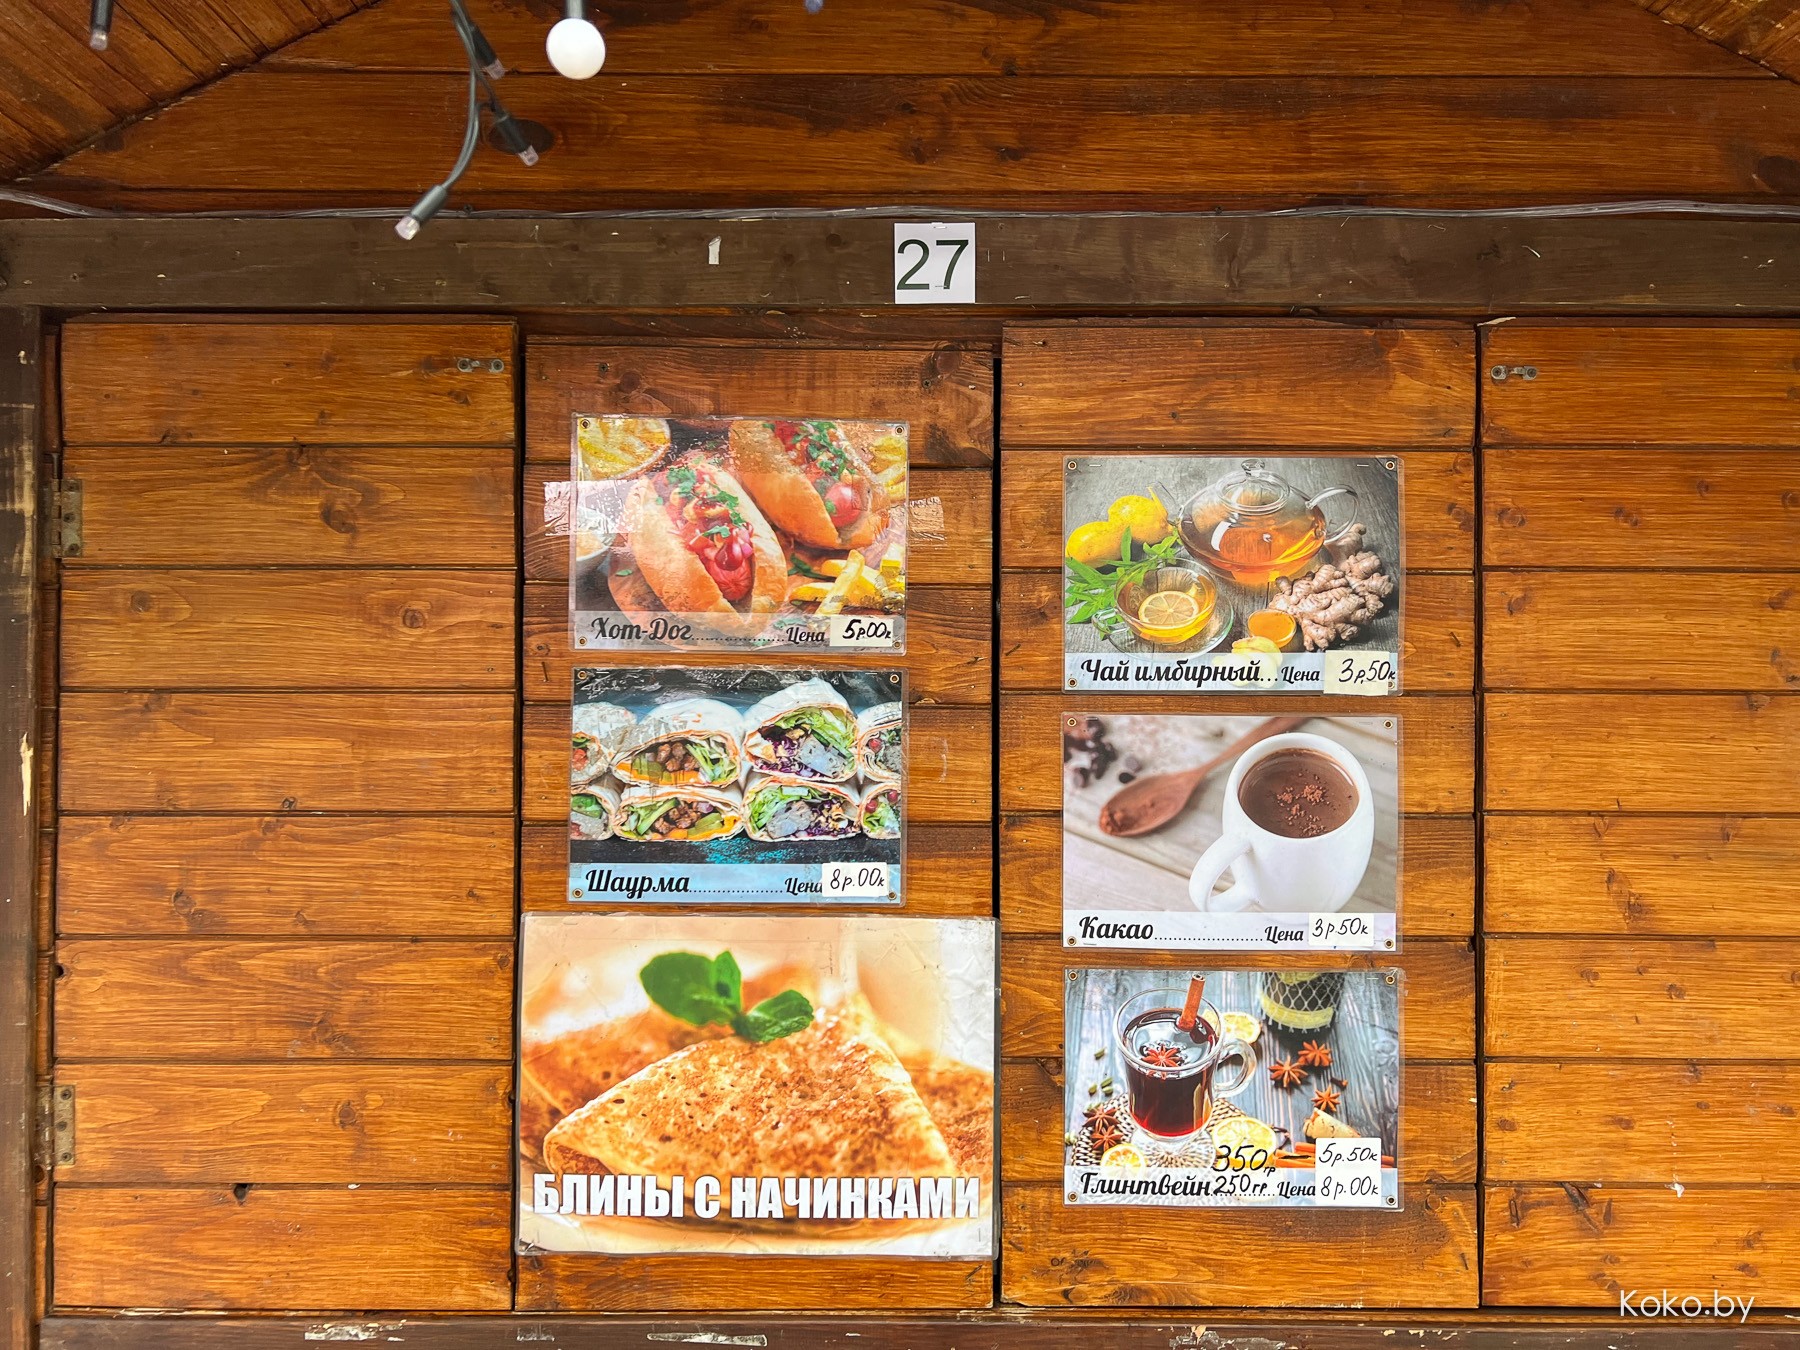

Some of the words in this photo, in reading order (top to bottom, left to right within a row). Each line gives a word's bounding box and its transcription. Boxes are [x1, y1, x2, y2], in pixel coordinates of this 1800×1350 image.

[897, 239, 969, 290] 27
[591, 617, 693, 640] Хот-Дог
[785, 626, 825, 644] Цена
[1080, 659, 1130, 682] Чай
[1281, 666, 1320, 684] Цена
[585, 869, 691, 899] Шаурма
[784, 877, 823, 896] Цена
[1078, 916, 1154, 940] Какао
[1264, 926, 1304, 944] Цена
[532, 1172, 684, 1218] БЛИНЫ
[694, 1174, 721, 1219] С
[731, 1175, 980, 1219] НАЧИНКАМИ
[1080, 1172, 1211, 1197] Глинтвейн
[1277, 1181, 1316, 1199] Цена
